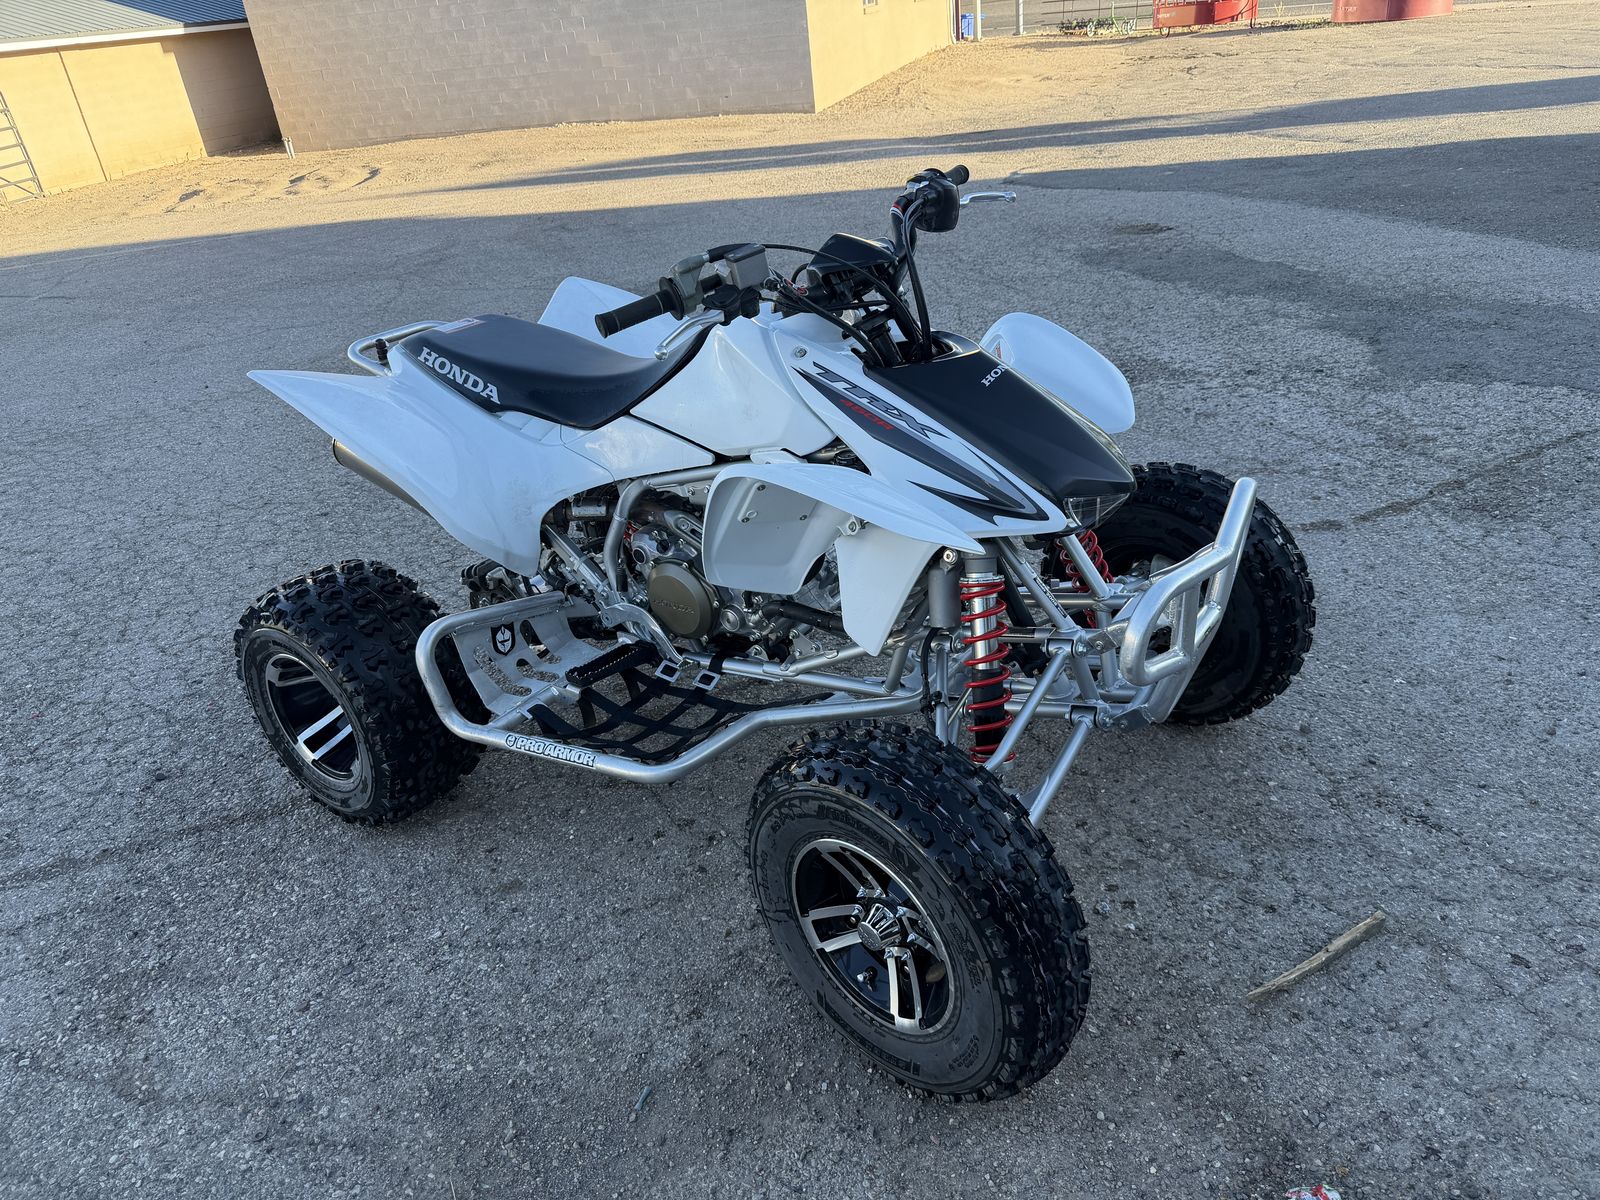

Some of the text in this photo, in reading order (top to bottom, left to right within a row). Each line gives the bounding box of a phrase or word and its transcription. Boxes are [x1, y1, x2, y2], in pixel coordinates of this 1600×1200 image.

[417, 346, 501, 405] HONDA
[813, 361, 952, 440] TRX
[516, 736, 596, 767] PRO ARMOR
